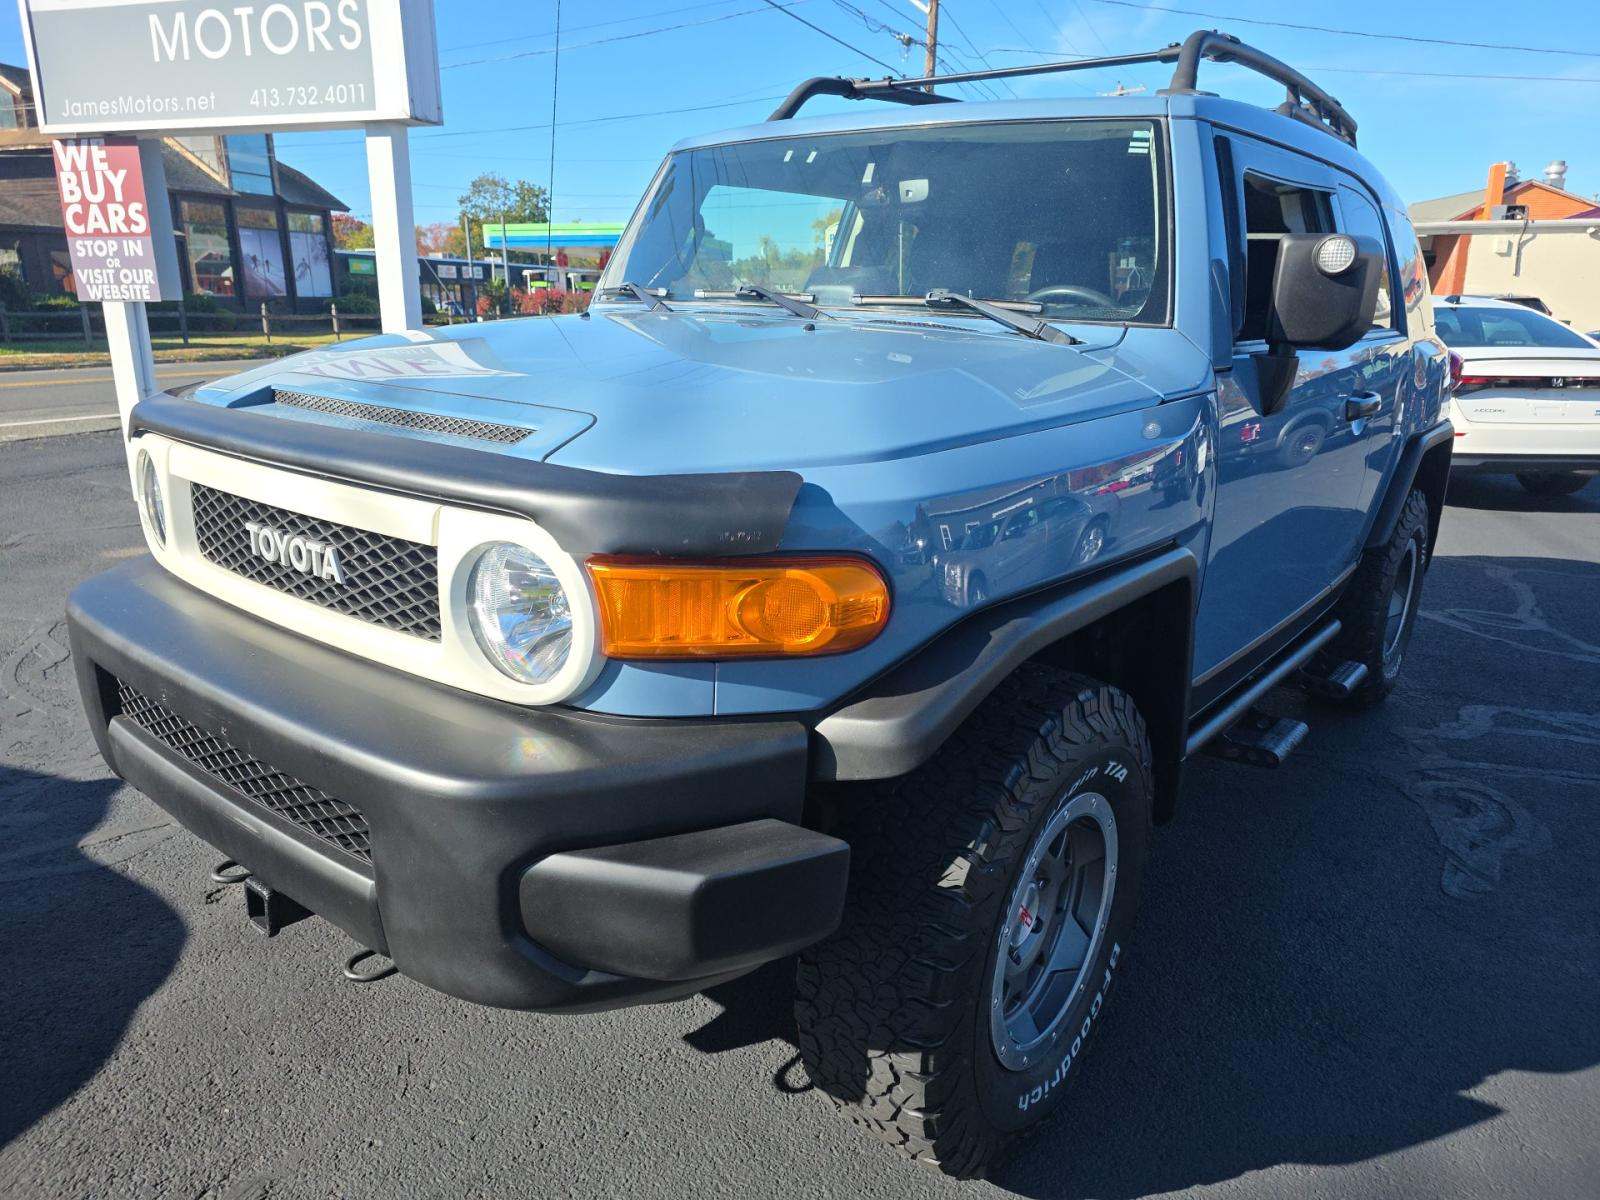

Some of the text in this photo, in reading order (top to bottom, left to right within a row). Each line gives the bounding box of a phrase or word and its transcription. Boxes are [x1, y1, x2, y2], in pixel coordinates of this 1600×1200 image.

[148, 0, 363, 63] MOTORS
[61, 83, 366, 118] JamesMotors.net 413.732.4011
[52, 139, 109, 172] WE
[60, 169, 127, 204] BUY
[65, 202, 147, 234] CARS
[75, 240, 144, 257] STOP IN
[106, 258, 121, 268] OR
[77, 269, 155, 284] VISIT OUR
[86, 284, 151, 300] WEBSITE
[245, 523, 343, 584] TOYOTA
[1103, 760, 1128, 783] T/A
